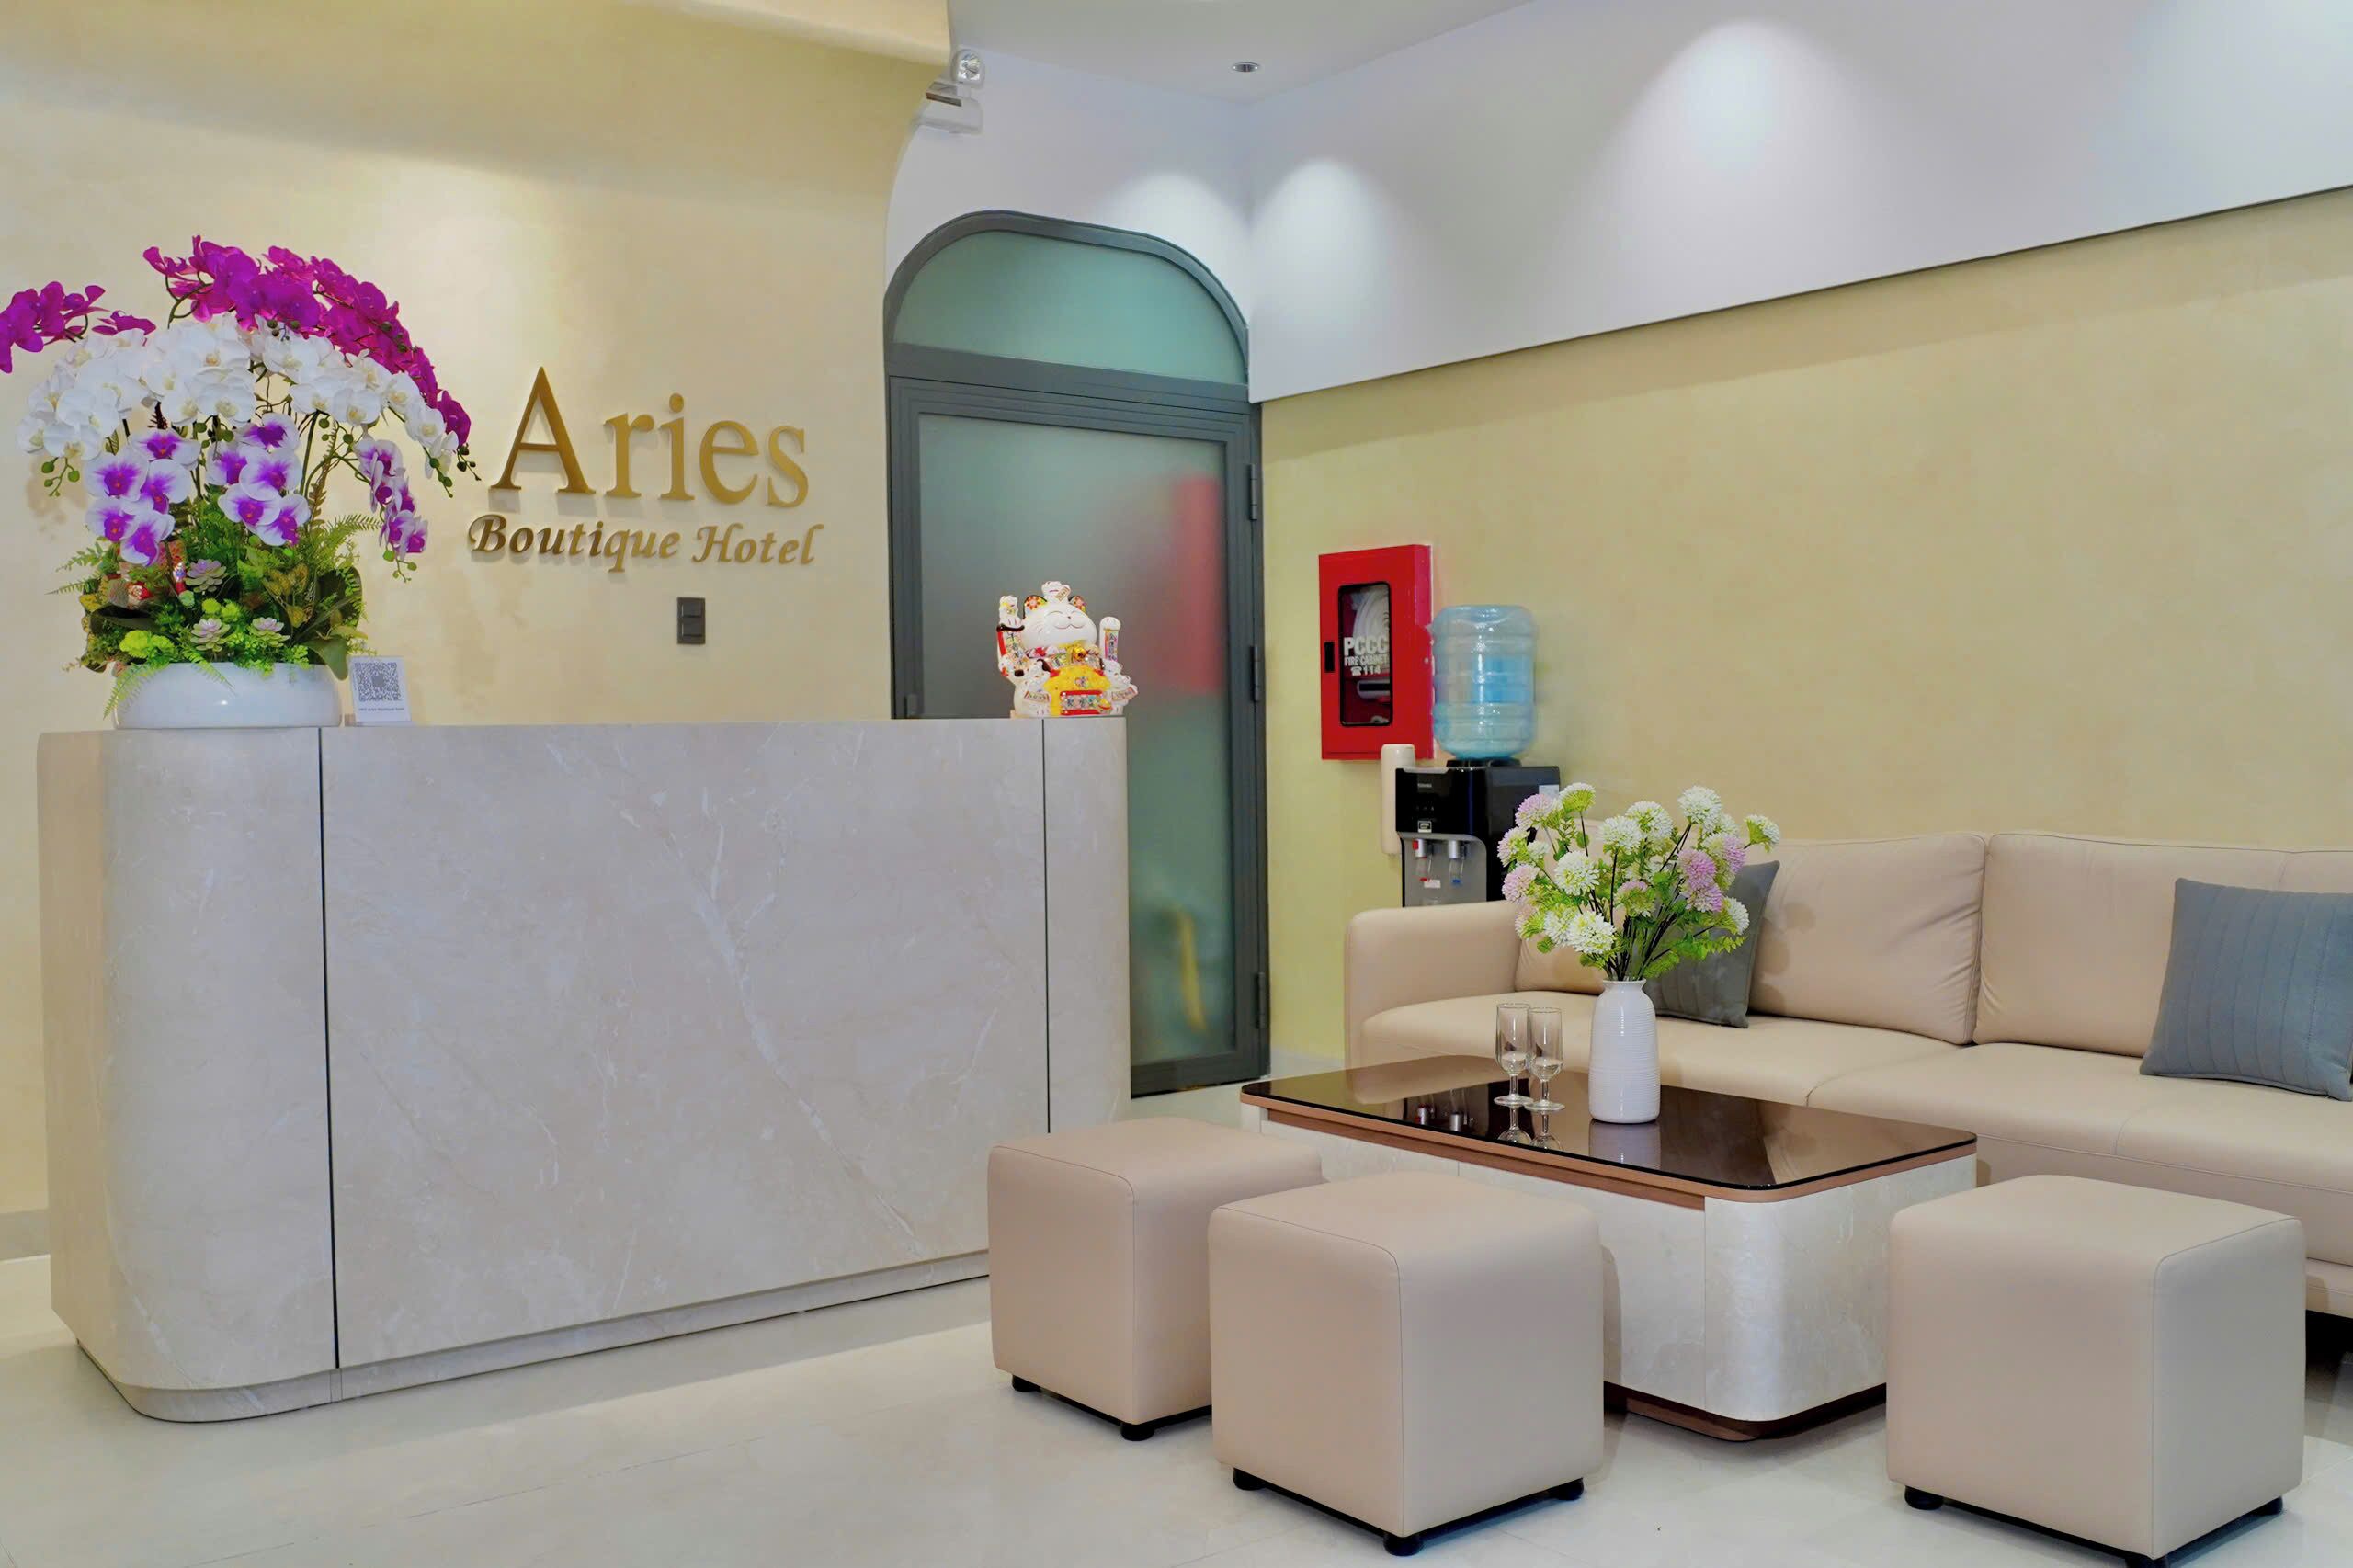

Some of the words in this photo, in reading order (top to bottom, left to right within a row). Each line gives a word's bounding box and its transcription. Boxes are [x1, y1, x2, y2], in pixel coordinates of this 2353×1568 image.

[491, 366, 809, 508] Aries
[468, 514, 681, 573] Boutique
[692, 523, 824, 565] Hotel
[1344, 636, 1389, 655] PCCC
[1344, 655, 1358, 666] FIRE
[1364, 665, 1381, 676] 114
